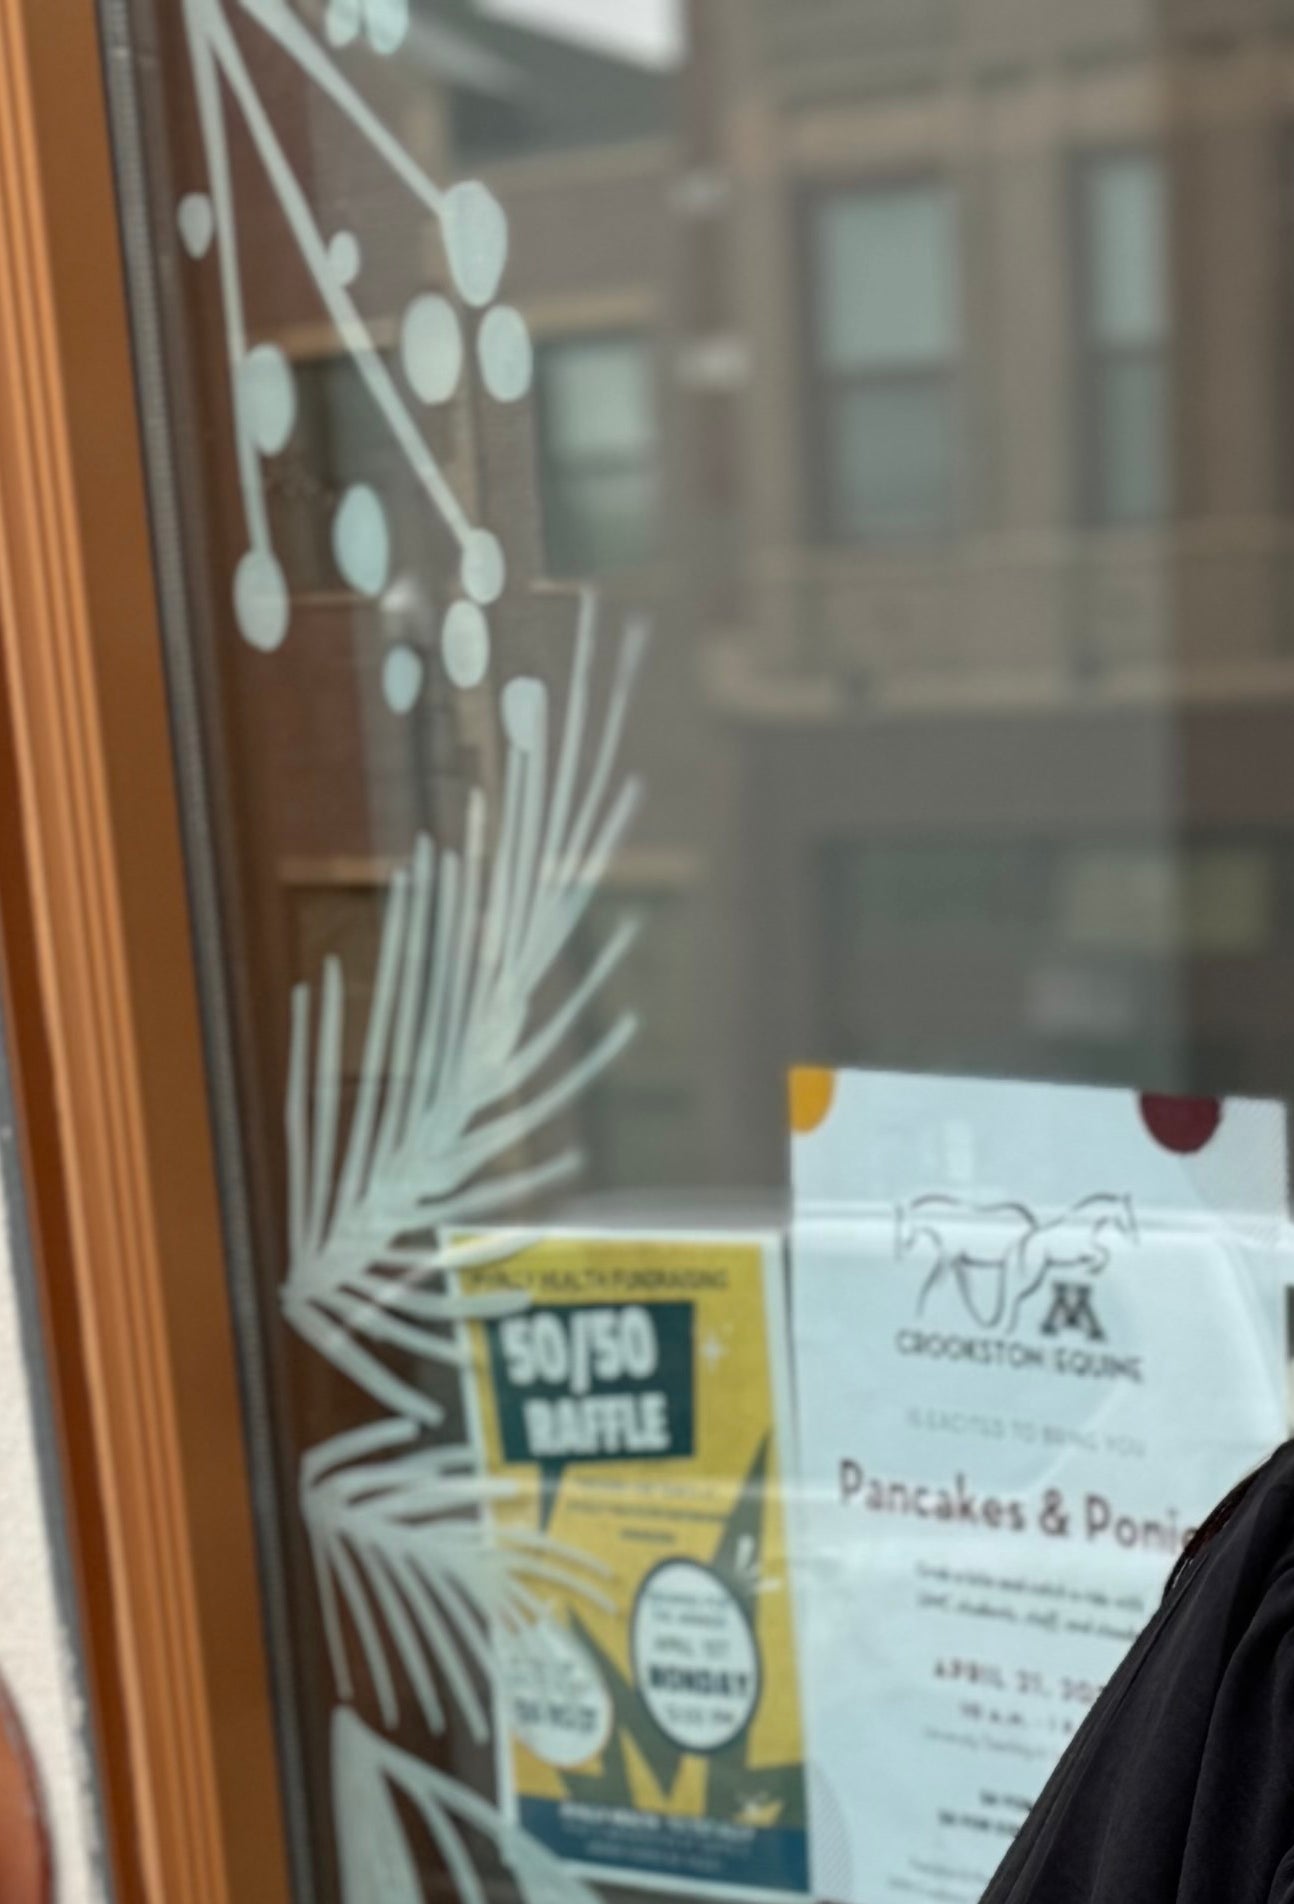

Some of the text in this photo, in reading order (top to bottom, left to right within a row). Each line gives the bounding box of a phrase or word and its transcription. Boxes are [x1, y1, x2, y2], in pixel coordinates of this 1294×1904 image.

[502, 1306, 657, 1395] 50/50
[897, 1330, 1142, 1383] CROOKSTON EQUINE
[524, 1392, 672, 1456] RAFFLE
[840, 1458, 1200, 1552] Pancakes & Ponie
[650, 1666, 748, 1697] MONDAY
[935, 1658, 1005, 1691] APRIL
[1060, 1676, 1104, 1703] 20
